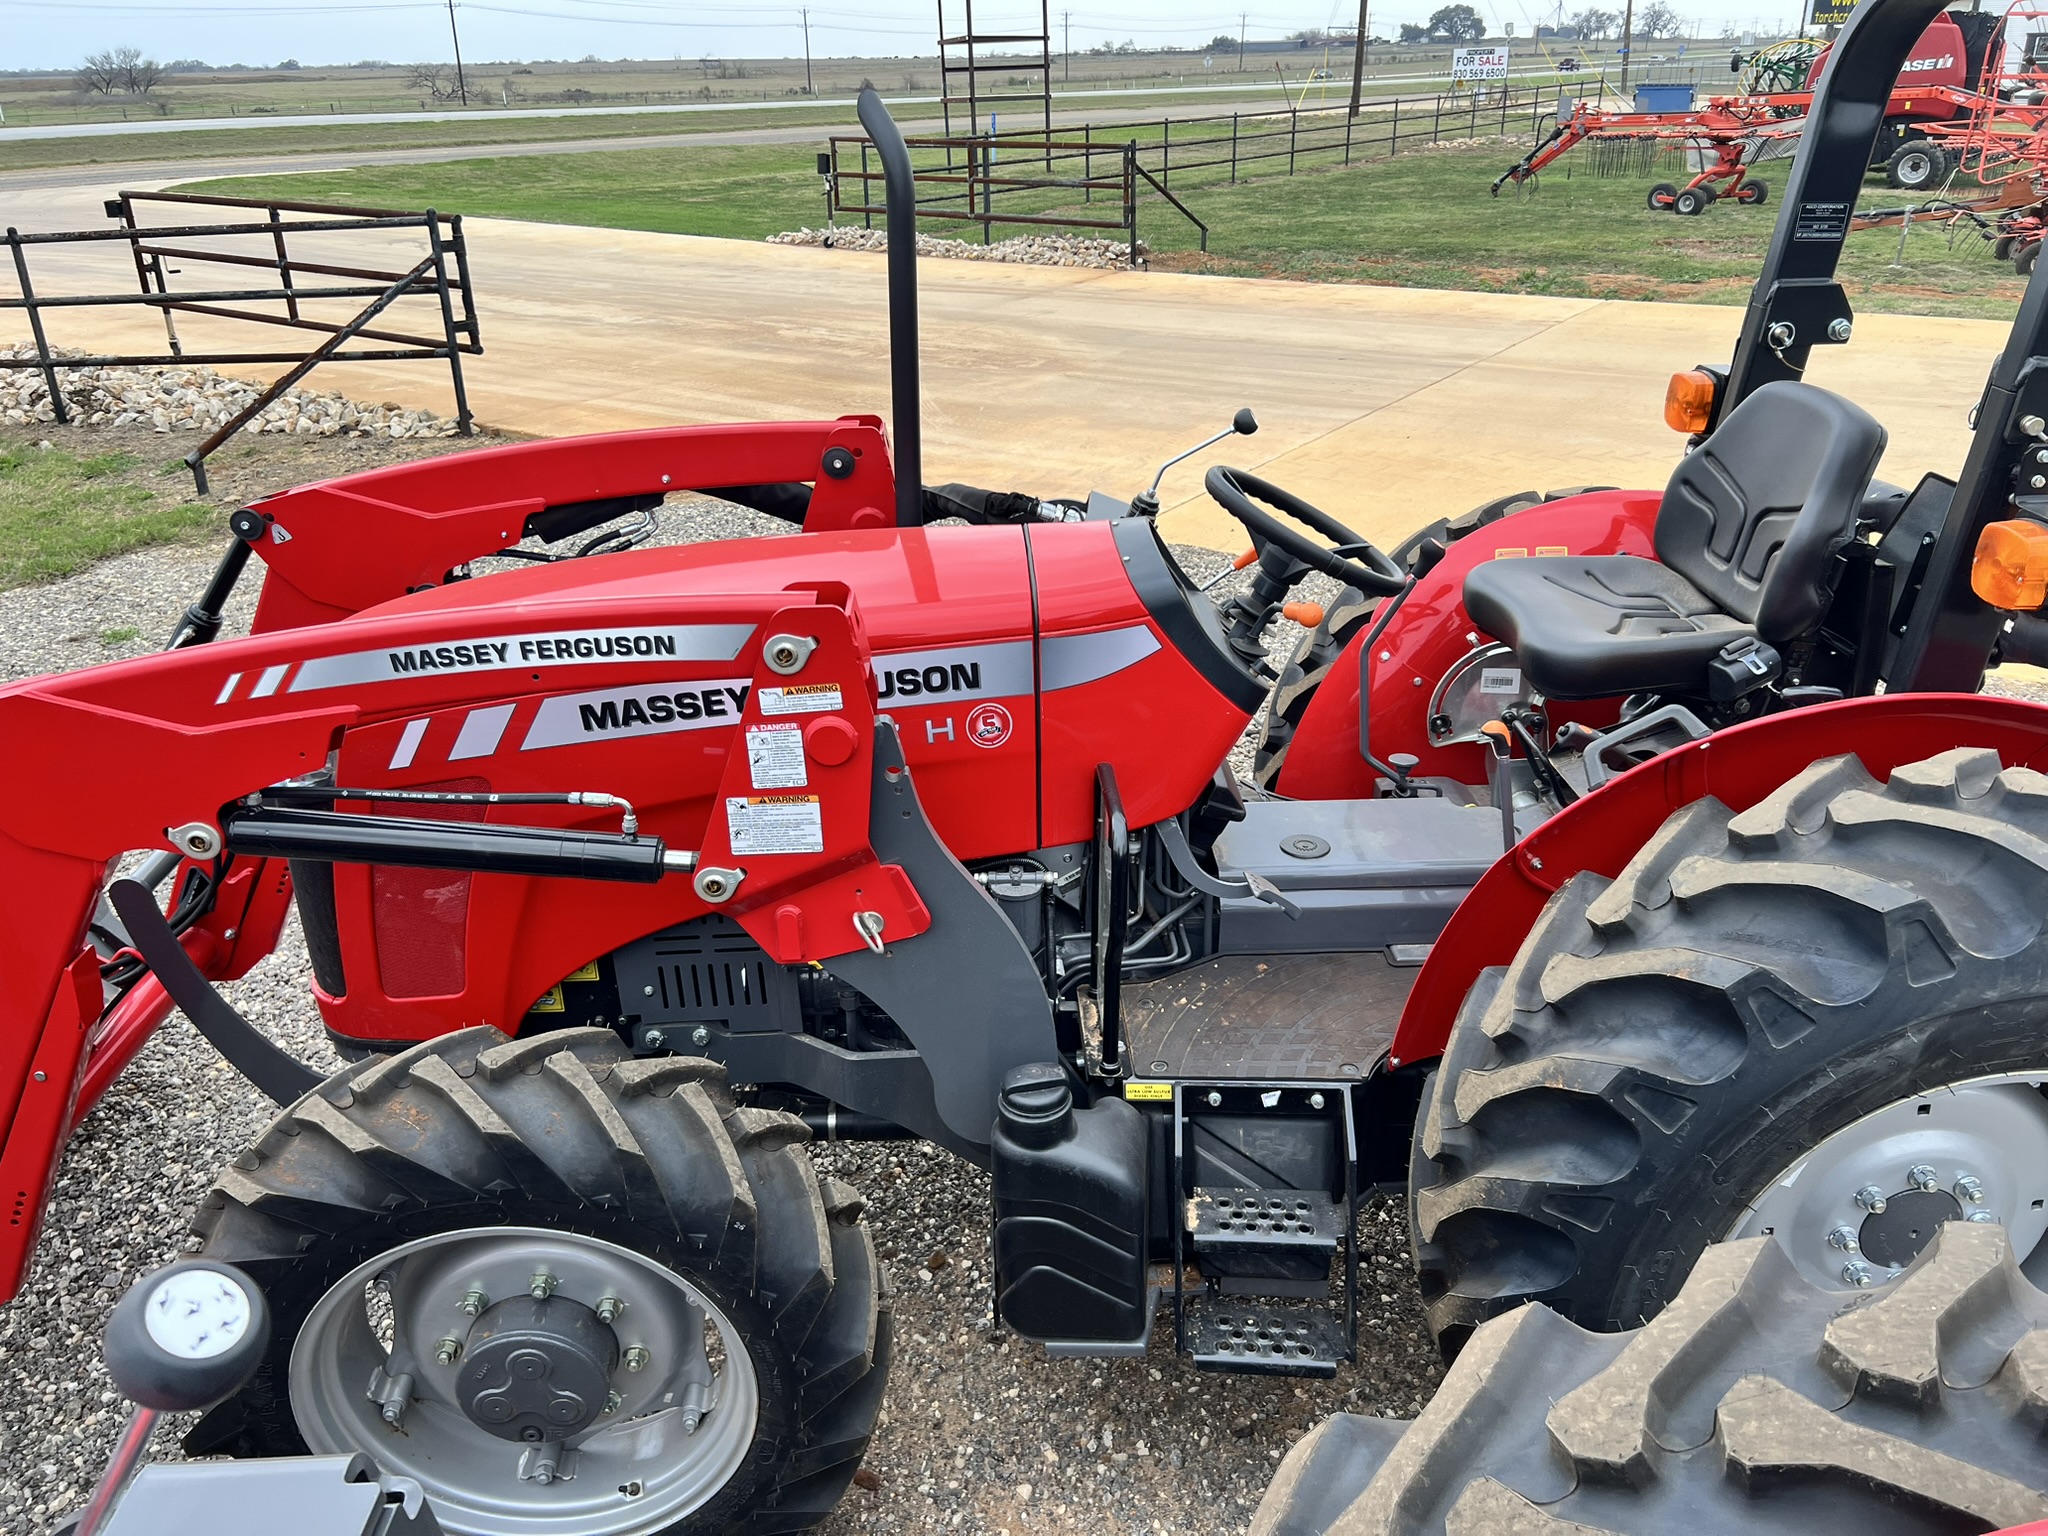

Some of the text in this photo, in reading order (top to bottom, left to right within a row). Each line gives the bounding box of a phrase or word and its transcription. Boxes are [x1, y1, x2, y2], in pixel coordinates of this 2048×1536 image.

[1456, 55, 1504, 66] FOR SALE
[1900, 58, 1936, 73] ASE
[1453, 68, 1505, 78] 830 569 6500
[388, 635, 677, 675] MASSEY FERGUSON
[875, 662, 981, 699] USON
[795, 684, 838, 695] WARNING
[579, 685, 751, 733] MASSEY
[760, 722, 798, 732] DANGER
[982, 713, 997, 728] 5
[768, 795, 811, 804] WARNING
